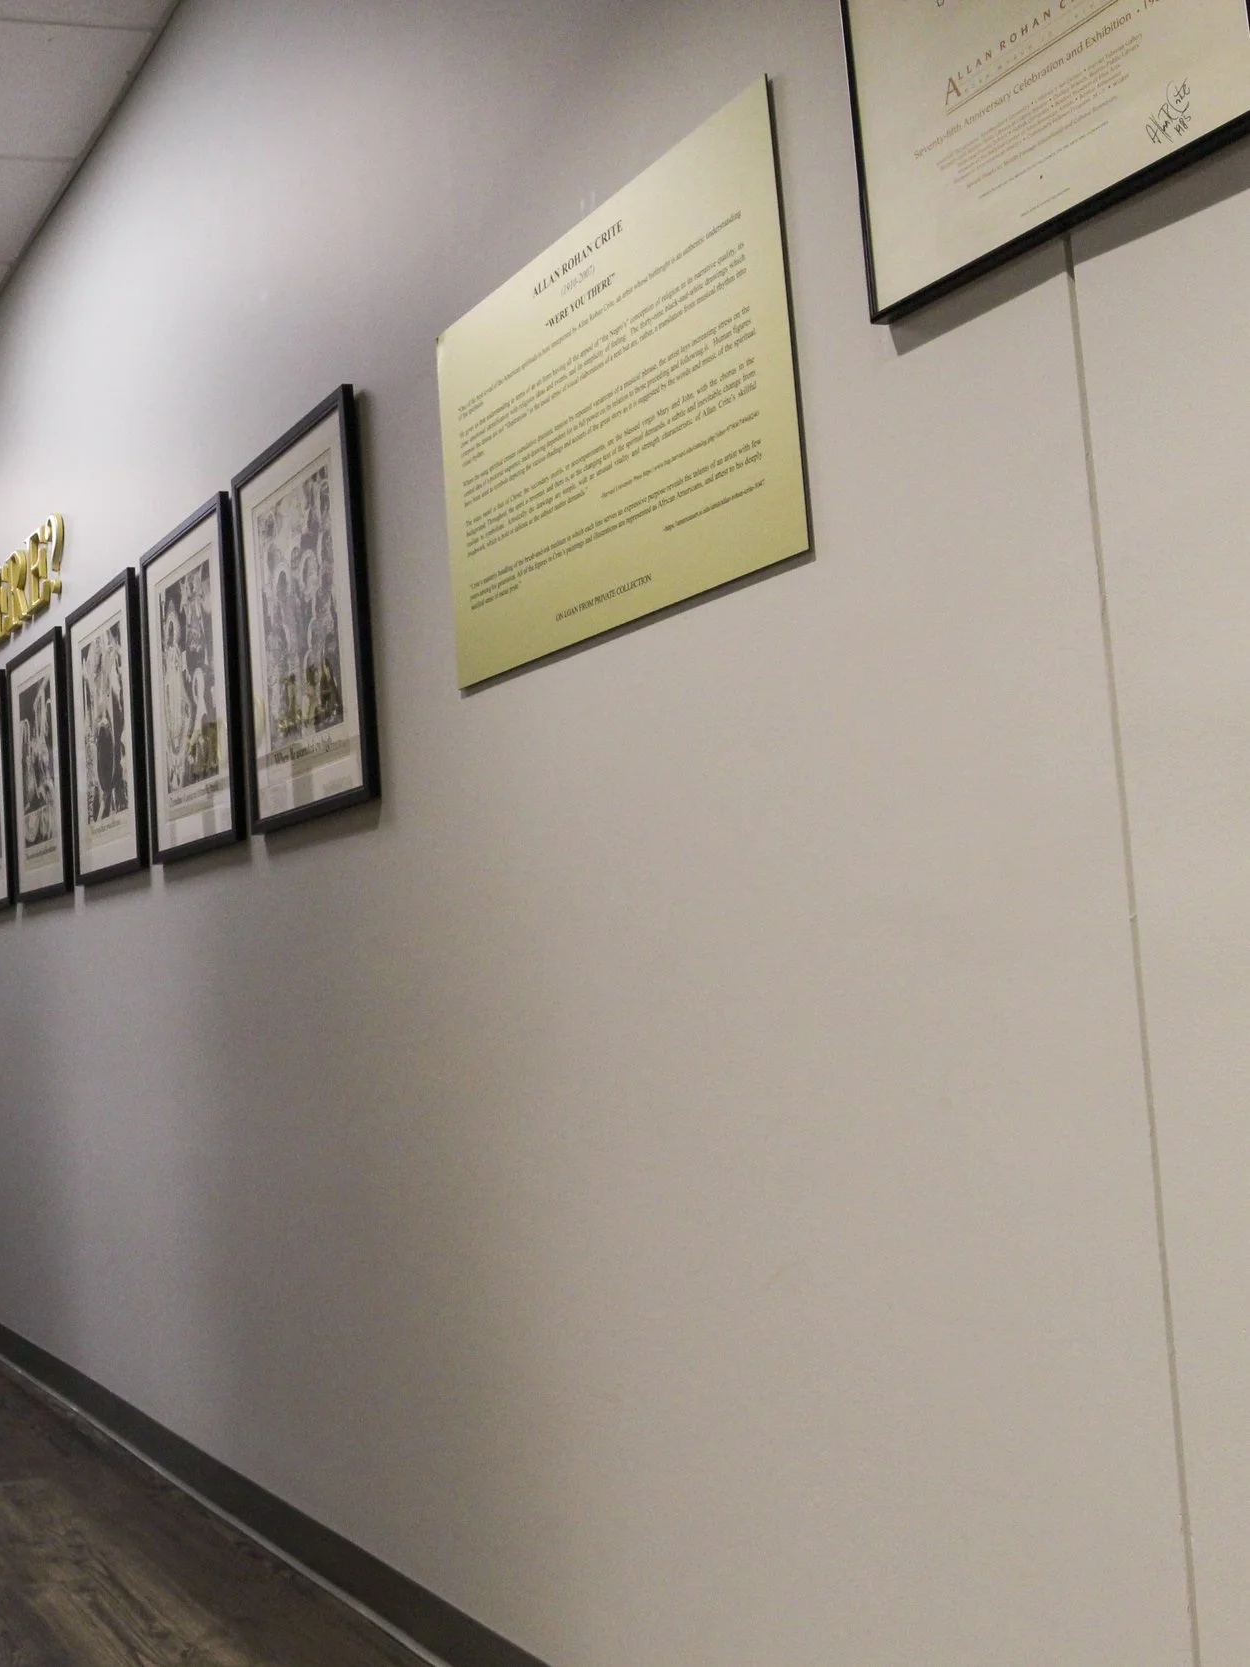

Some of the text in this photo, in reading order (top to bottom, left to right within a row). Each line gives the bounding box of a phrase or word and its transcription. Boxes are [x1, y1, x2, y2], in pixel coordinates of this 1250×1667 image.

[942, 48, 993, 105] ALLAN
[999, 7, 1051, 51] ROHAN
[963, 87, 1012, 130] Anniversary
[1012, 52, 1064, 96] Celebration
[1065, 40, 1083, 61] and
[1084, 8, 1132, 49] Exhibition
[531, 217, 623, 299] ALLAN ROHAN CRITE
[569, 292, 586, 314] YOU
[555, 572, 651, 621] ON LOAN FROM PRIVATE COLLECTION
